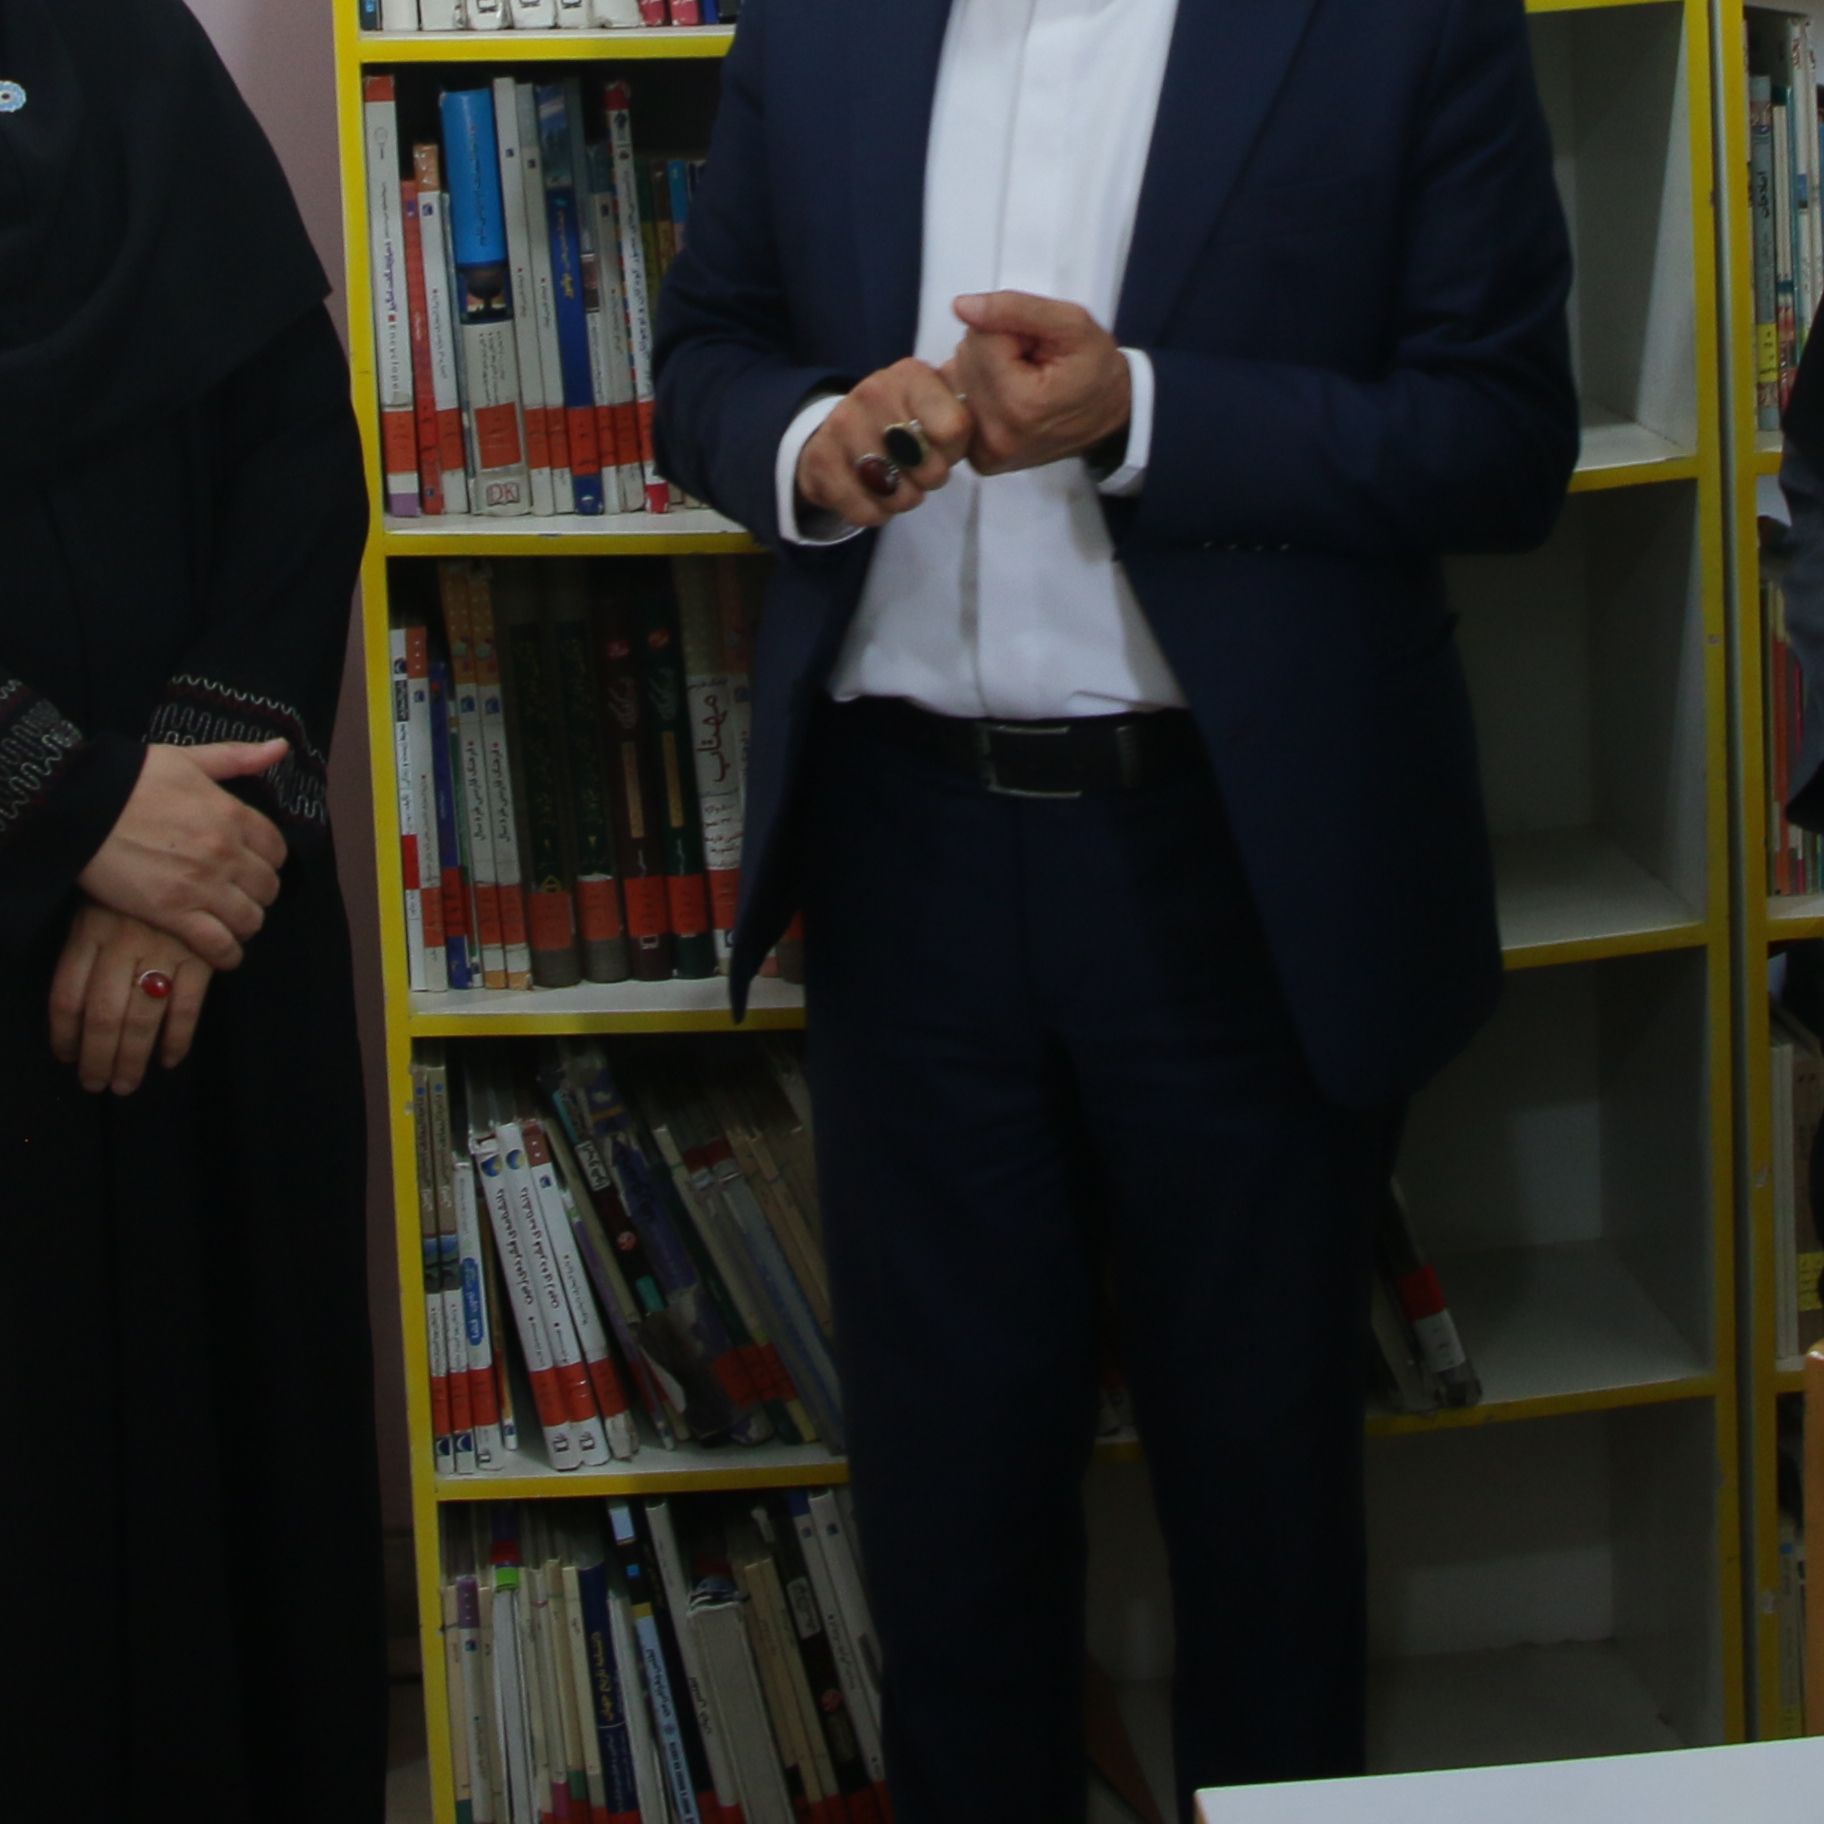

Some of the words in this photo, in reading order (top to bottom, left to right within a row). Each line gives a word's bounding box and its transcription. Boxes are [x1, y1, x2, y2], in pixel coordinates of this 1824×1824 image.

[486, 482, 519, 506] DK
[696, 694, 730, 783] مهتاب
[466, 747, 479, 777] فرهنگ
[491, 748, 503, 777] فرهنگ
[469, 777, 483, 807] فارسی
[493, 778, 509, 807] فارسی
[516, 1280, 534, 1305] زمین
[544, 1283, 560, 1309] زمین
